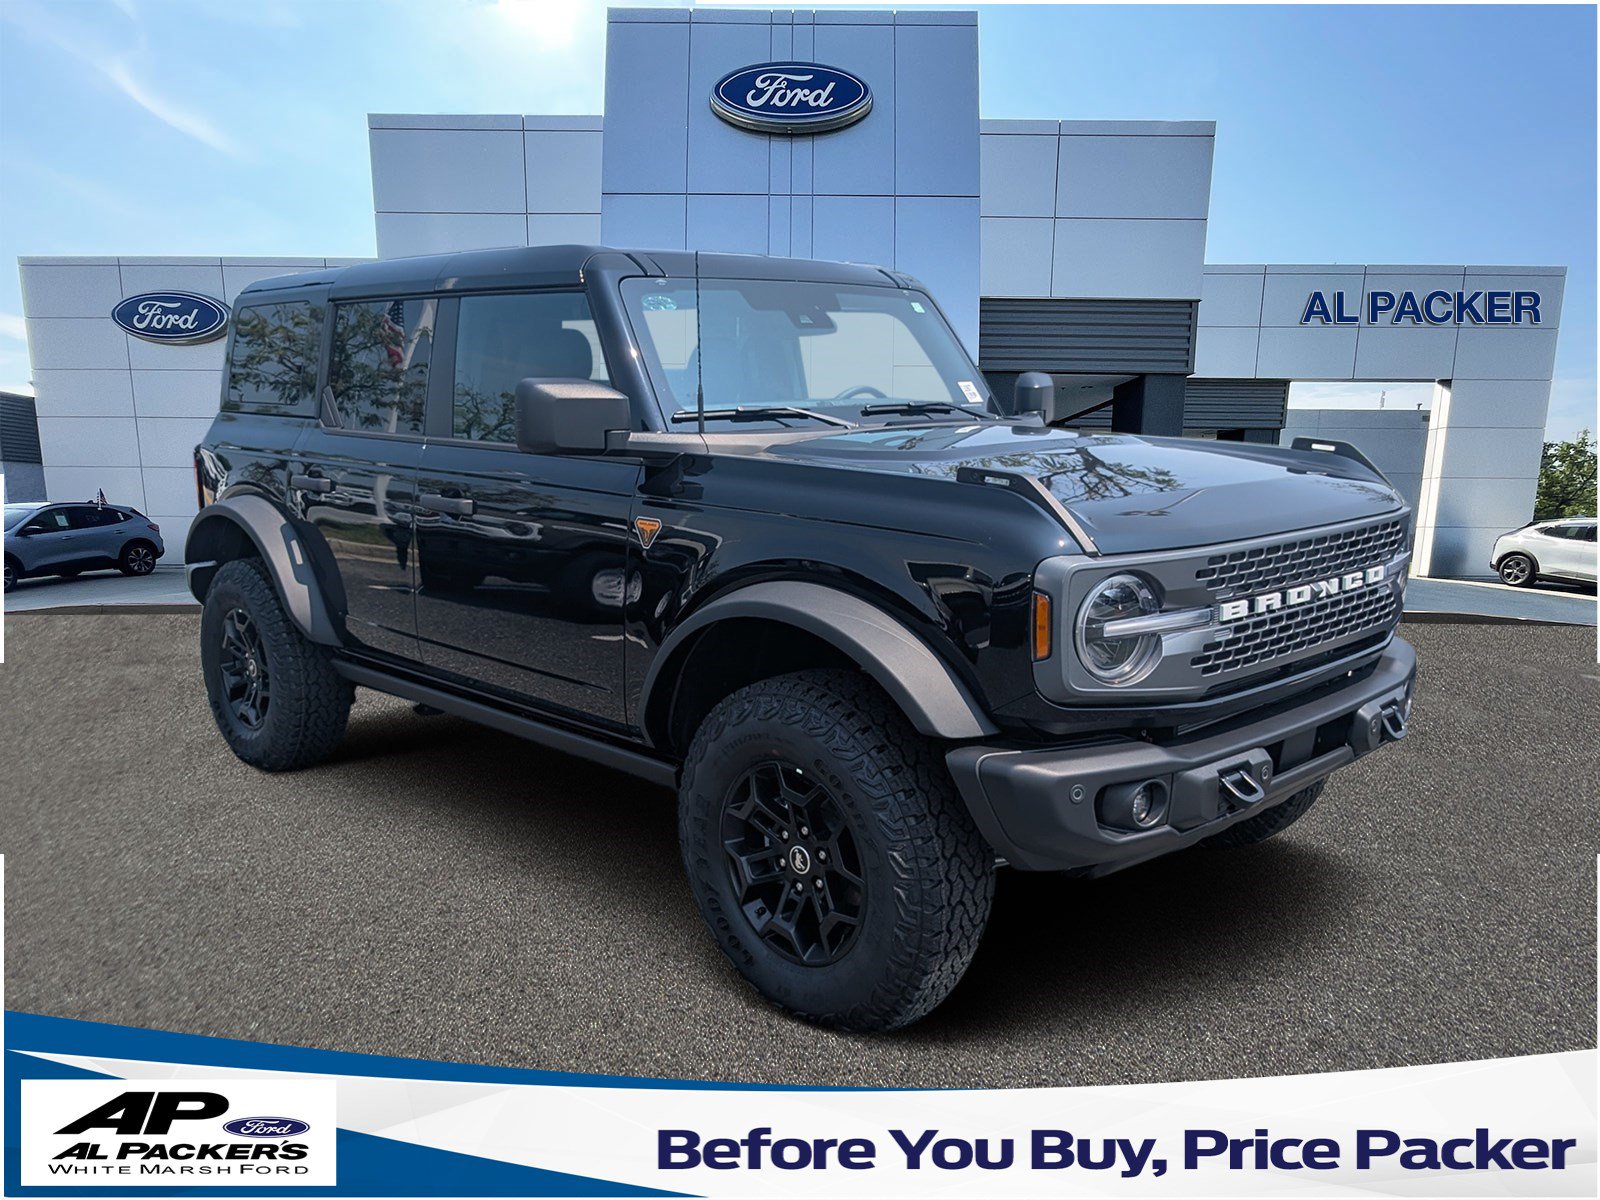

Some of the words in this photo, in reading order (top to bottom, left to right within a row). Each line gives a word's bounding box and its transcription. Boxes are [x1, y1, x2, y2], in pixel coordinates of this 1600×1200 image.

[746, 73, 836, 107] Ford
[133, 301, 199, 329] Ford
[1302, 291, 1360, 324] AL
[1369, 290, 1542, 325] PACKER
[1219, 565, 1385, 622] BRONCO
